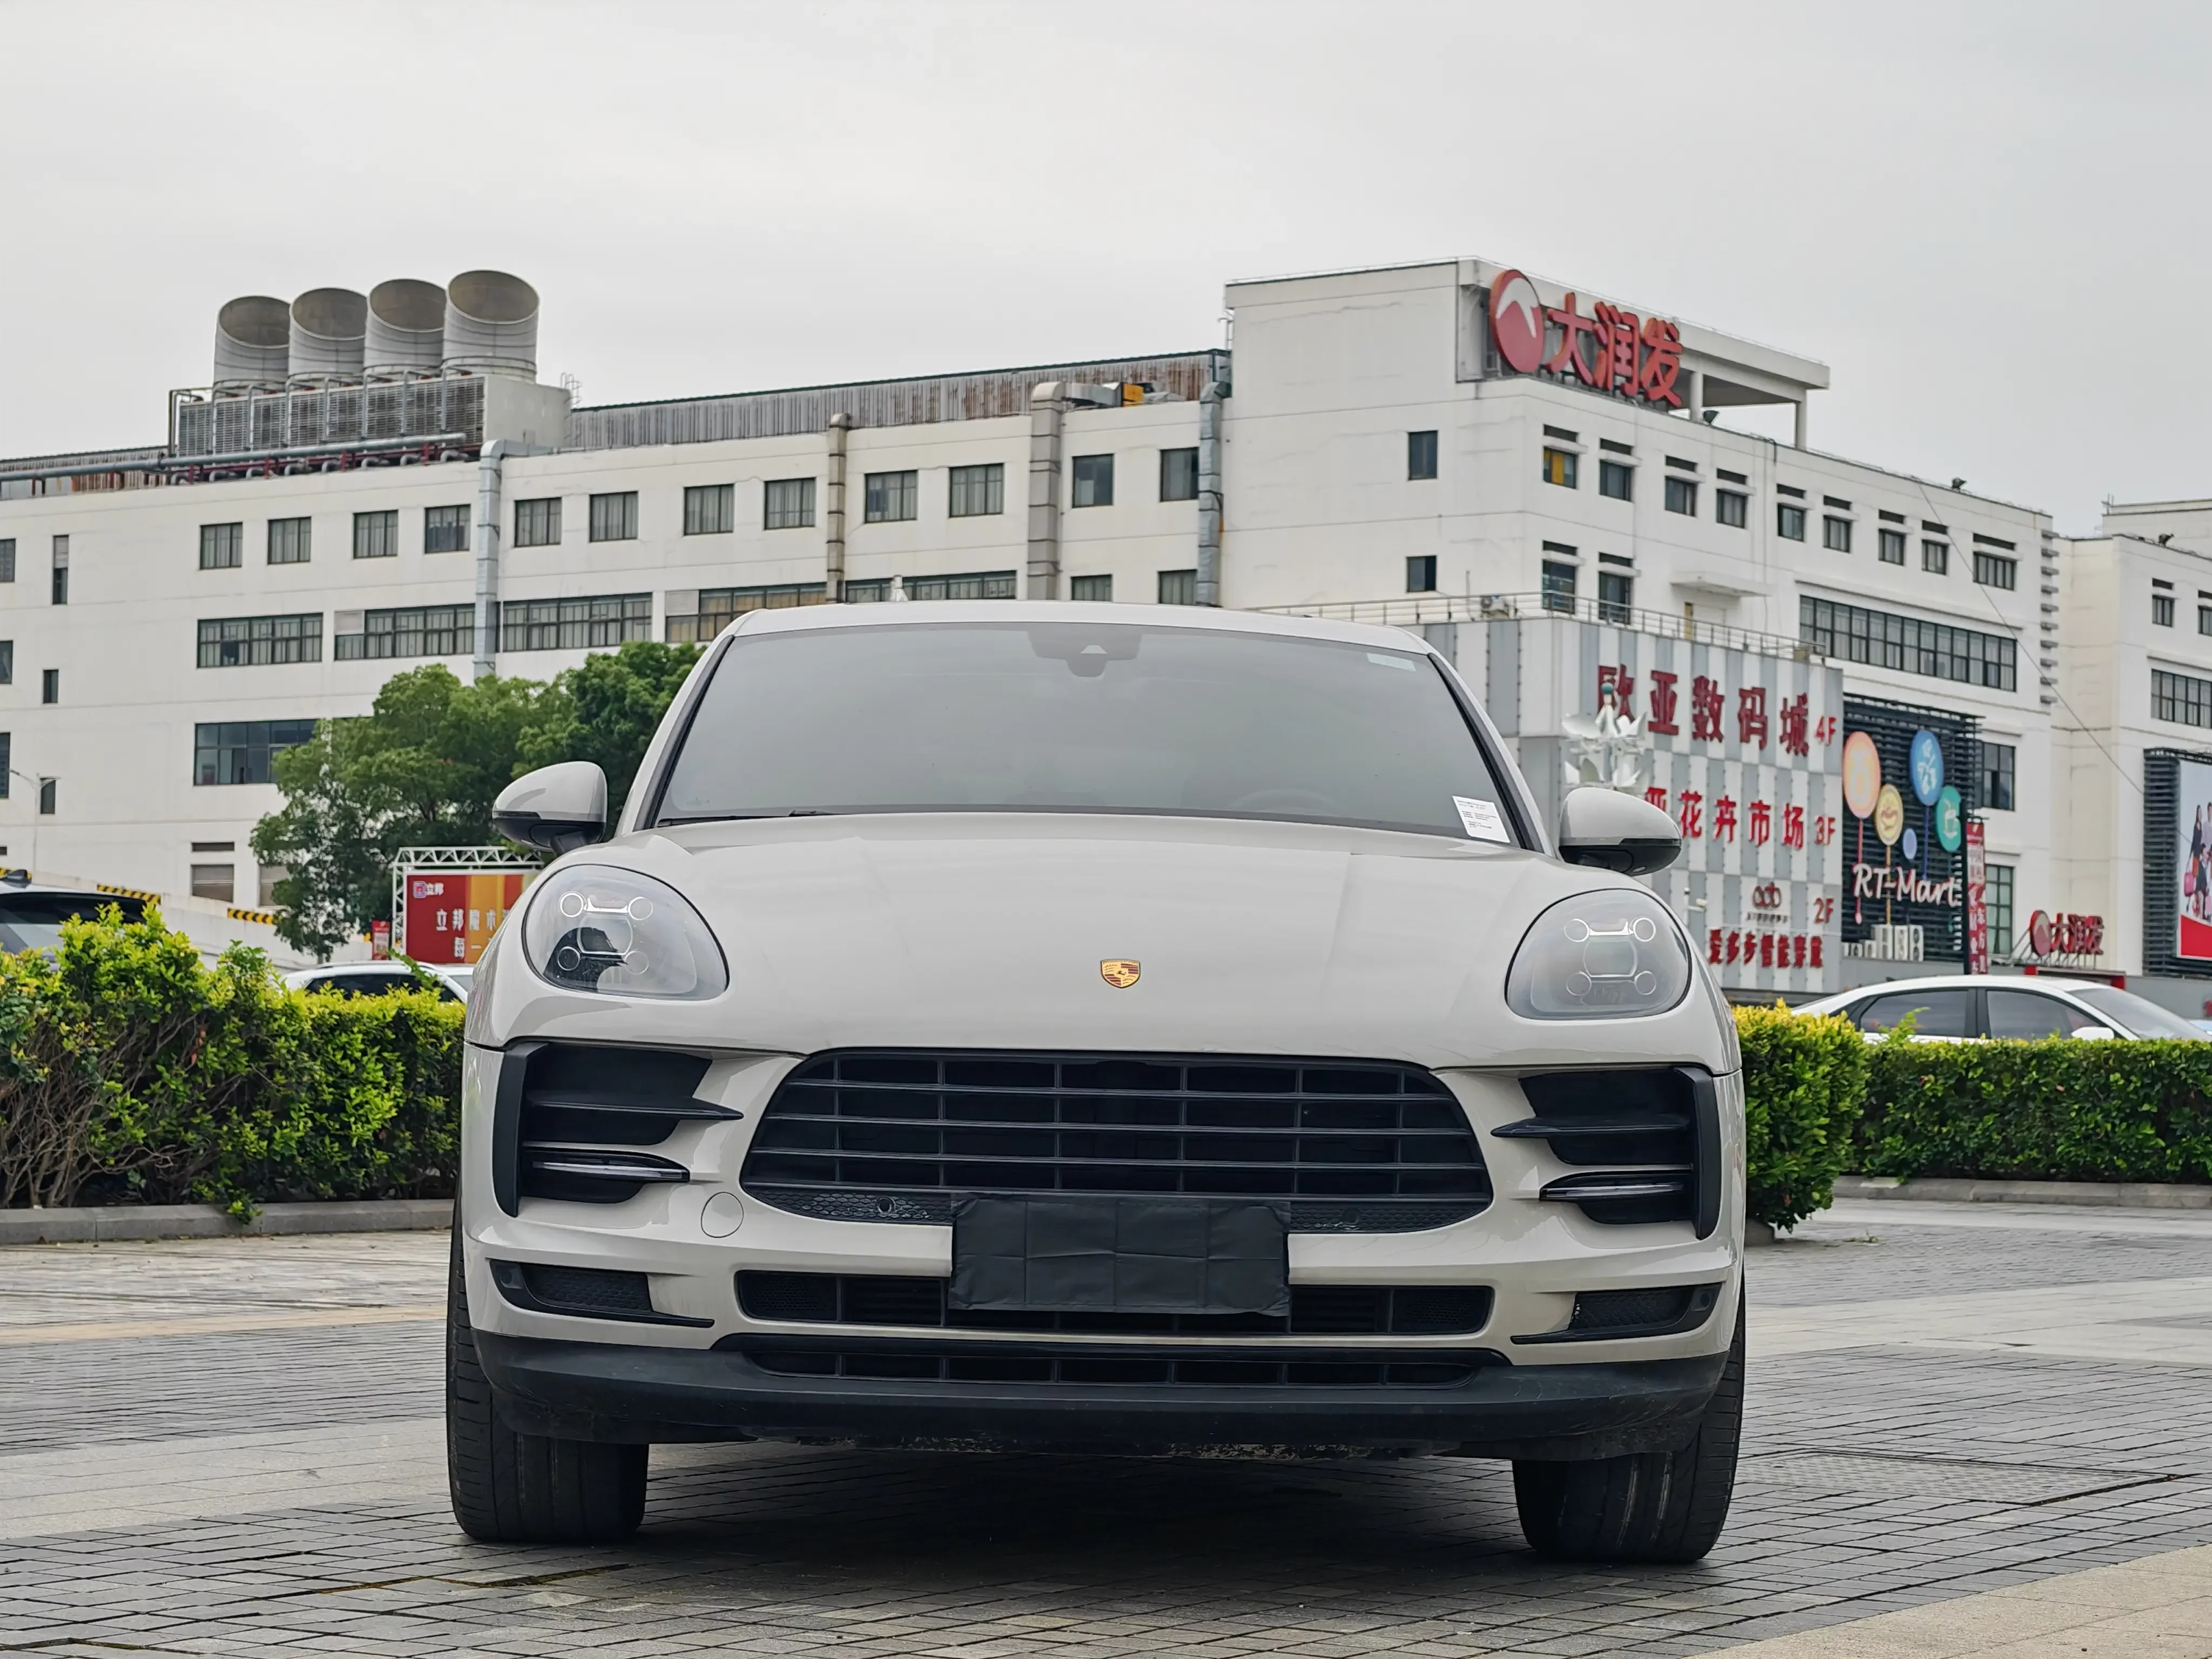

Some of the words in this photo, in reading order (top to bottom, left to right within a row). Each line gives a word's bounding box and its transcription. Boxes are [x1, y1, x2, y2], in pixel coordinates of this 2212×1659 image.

[1546, 292, 1683, 408] 大润发
[1598, 664, 1810, 757] 欧亚数码城
[1815, 716, 1836, 747] 4F
[1815, 815, 1836, 846] 3F
[1852, 864, 1958, 908] RT-Mart
[1813, 897, 1834, 924] 2F
[2048, 913, 2105, 955] 大润发
